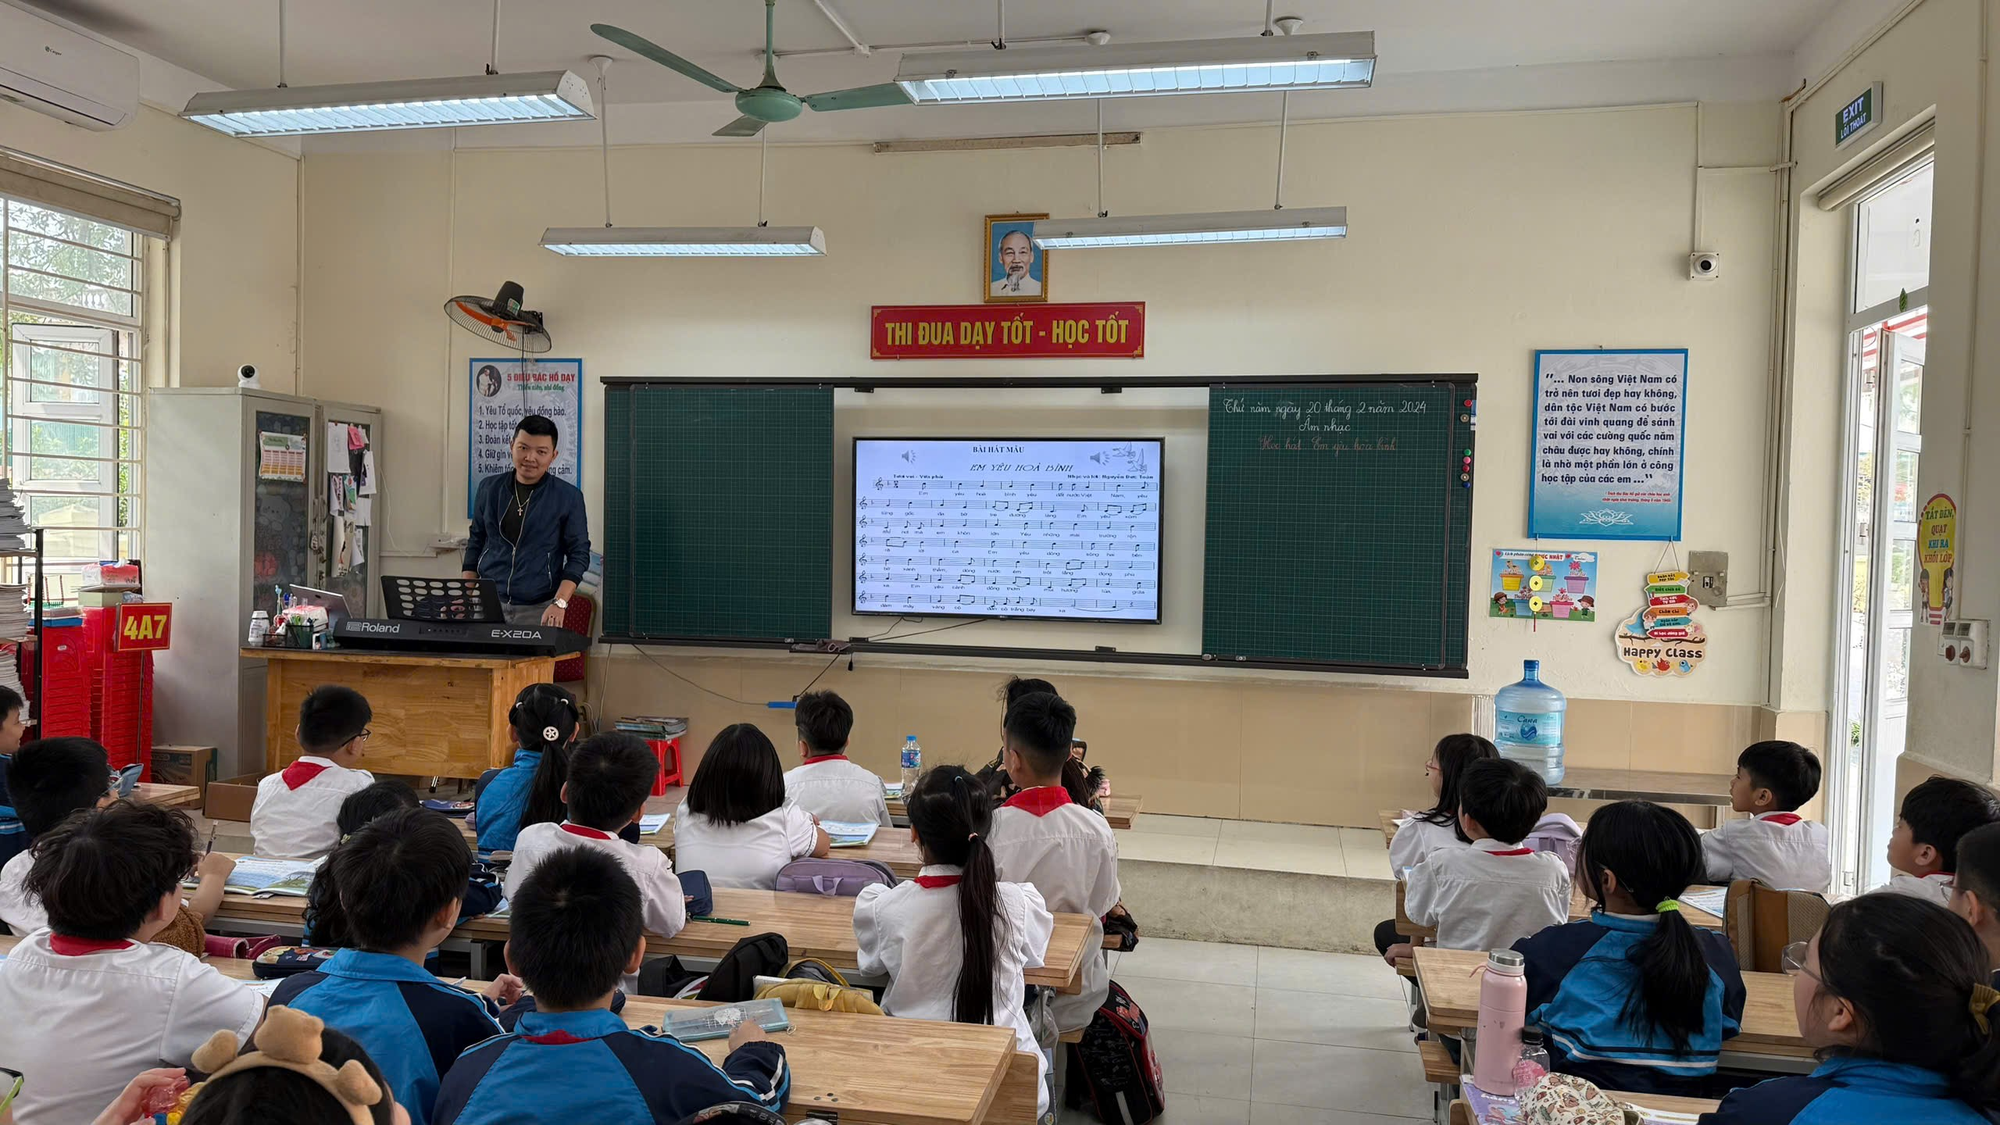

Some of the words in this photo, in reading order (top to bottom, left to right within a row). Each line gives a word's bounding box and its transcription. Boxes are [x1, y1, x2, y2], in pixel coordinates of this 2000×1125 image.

[1843, 96, 1864, 124] EXIT
[1850, 112, 1866, 132] THOÁT
[885, 322, 912, 346] THI
[918, 321, 954, 346] ĐUA
[960, 321, 996, 350] DẠY
[1001, 312, 1034, 345] TỐT
[1052, 319, 1089, 349] HỌC
[1095, 311, 1129, 344] TỐT
[507, 373, 512, 382] 5
[532, 371, 547, 382] BÁC
[549, 370, 559, 382] HỒ
[561, 372, 576, 383] DẠY
[1568, 374, 1587, 384] Non
[1591, 374, 1614, 386] sông
[1617, 374, 1637, 386] Việt
[1640, 374, 1662, 384] Nam
[1665, 374, 1677, 384] có
[1545, 387, 1559, 398] trở
[1562, 388, 1579, 398] nên
[1582, 388, 1601, 398] tươi
[1603, 388, 1621, 400] đẹp
[1624, 388, 1641, 399] hay
[1644, 388, 1677, 400] không,
[479, 406, 484, 415] 1.
[485, 405, 497, 415] Yêu
[498, 403, 506, 415] Tổ
[507, 403, 524, 417] quốc,
[537, 404, 552, 418] đồng
[554, 406, 567, 416] bào.
[1222, 397, 1245, 414] Thứ
[1250, 401, 1271, 414] năm
[1275, 400, 1301, 421] ngày
[1305, 401, 1321, 414] 20
[1324, 399, 1352, 421] tháng
[1356, 401, 1367, 414] 2
[1368, 400, 1395, 414] năm
[1399, 400, 1427, 414] 2024
[1544, 403, 1563, 412] dân
[1566, 403, 1582, 414] tộc
[1585, 402, 1606, 414] Việt
[1609, 403, 1632, 412] Nam
[1635, 402, 1647, 412] có
[1650, 403, 1676, 412] bước
[479, 420, 484, 430] 2.
[485, 420, 497, 431] Học
[498, 420, 508, 432] tập
[1299, 414, 1320, 432] Âm
[1323, 417, 1351, 435] nhạc
[1544, 417, 1557, 426] tới
[1561, 416, 1576, 426] đài
[1579, 417, 1600, 426] vinh
[1603, 419, 1633, 428] quang
[1636, 414, 1650, 427] để
[1651, 417, 1675, 427] sánh
[478, 435, 484, 444] 3.
[485, 434, 501, 445] Đoàn
[1543, 431, 1557, 440] vai
[1560, 431, 1574, 440] với
[1577, 431, 1594, 440] các
[1596, 430, 1625, 442] cường
[1628, 429, 1651, 442] quốc
[1654, 431, 1675, 441] năm
[478, 450, 484, 459] 4.
[485, 449, 497, 459] Giữ
[988, 444, 1004, 453] HÁT
[1542, 446, 1565, 455] châu
[1567, 445, 1591, 457] được
[1593, 446, 1610, 457] hay
[1613, 446, 1645, 457] không,
[1648, 446, 1674, 456] chính
[478, 464, 484, 473] 5.
[485, 463, 504, 473] Khiêm
[557, 464, 572, 475] cảm.
[1542, 459, 1551, 468] là
[1553, 459, 1571, 468] nhờ
[1574, 460, 1593, 471] một
[1595, 458, 1620, 471] phần
[1623, 460, 1638, 469] lớn
[1641, 459, 1647, 469] ở
[1650, 460, 1674, 471] công
[1541, 474, 1558, 485] học
[1561, 474, 1576, 485] tập
[1578, 473, 1596, 483] của
[1598, 474, 1614, 483] các
[1931, 524, 1948, 537] QUẠT
[1928, 539, 1939, 549] KHI
[1940, 538, 1949, 549] RA
[124, 615, 167, 640] 4A7
[361, 623, 400, 634] Roland
[1623, 647, 1661, 658] Happy
[1665, 647, 1703, 658] Class
